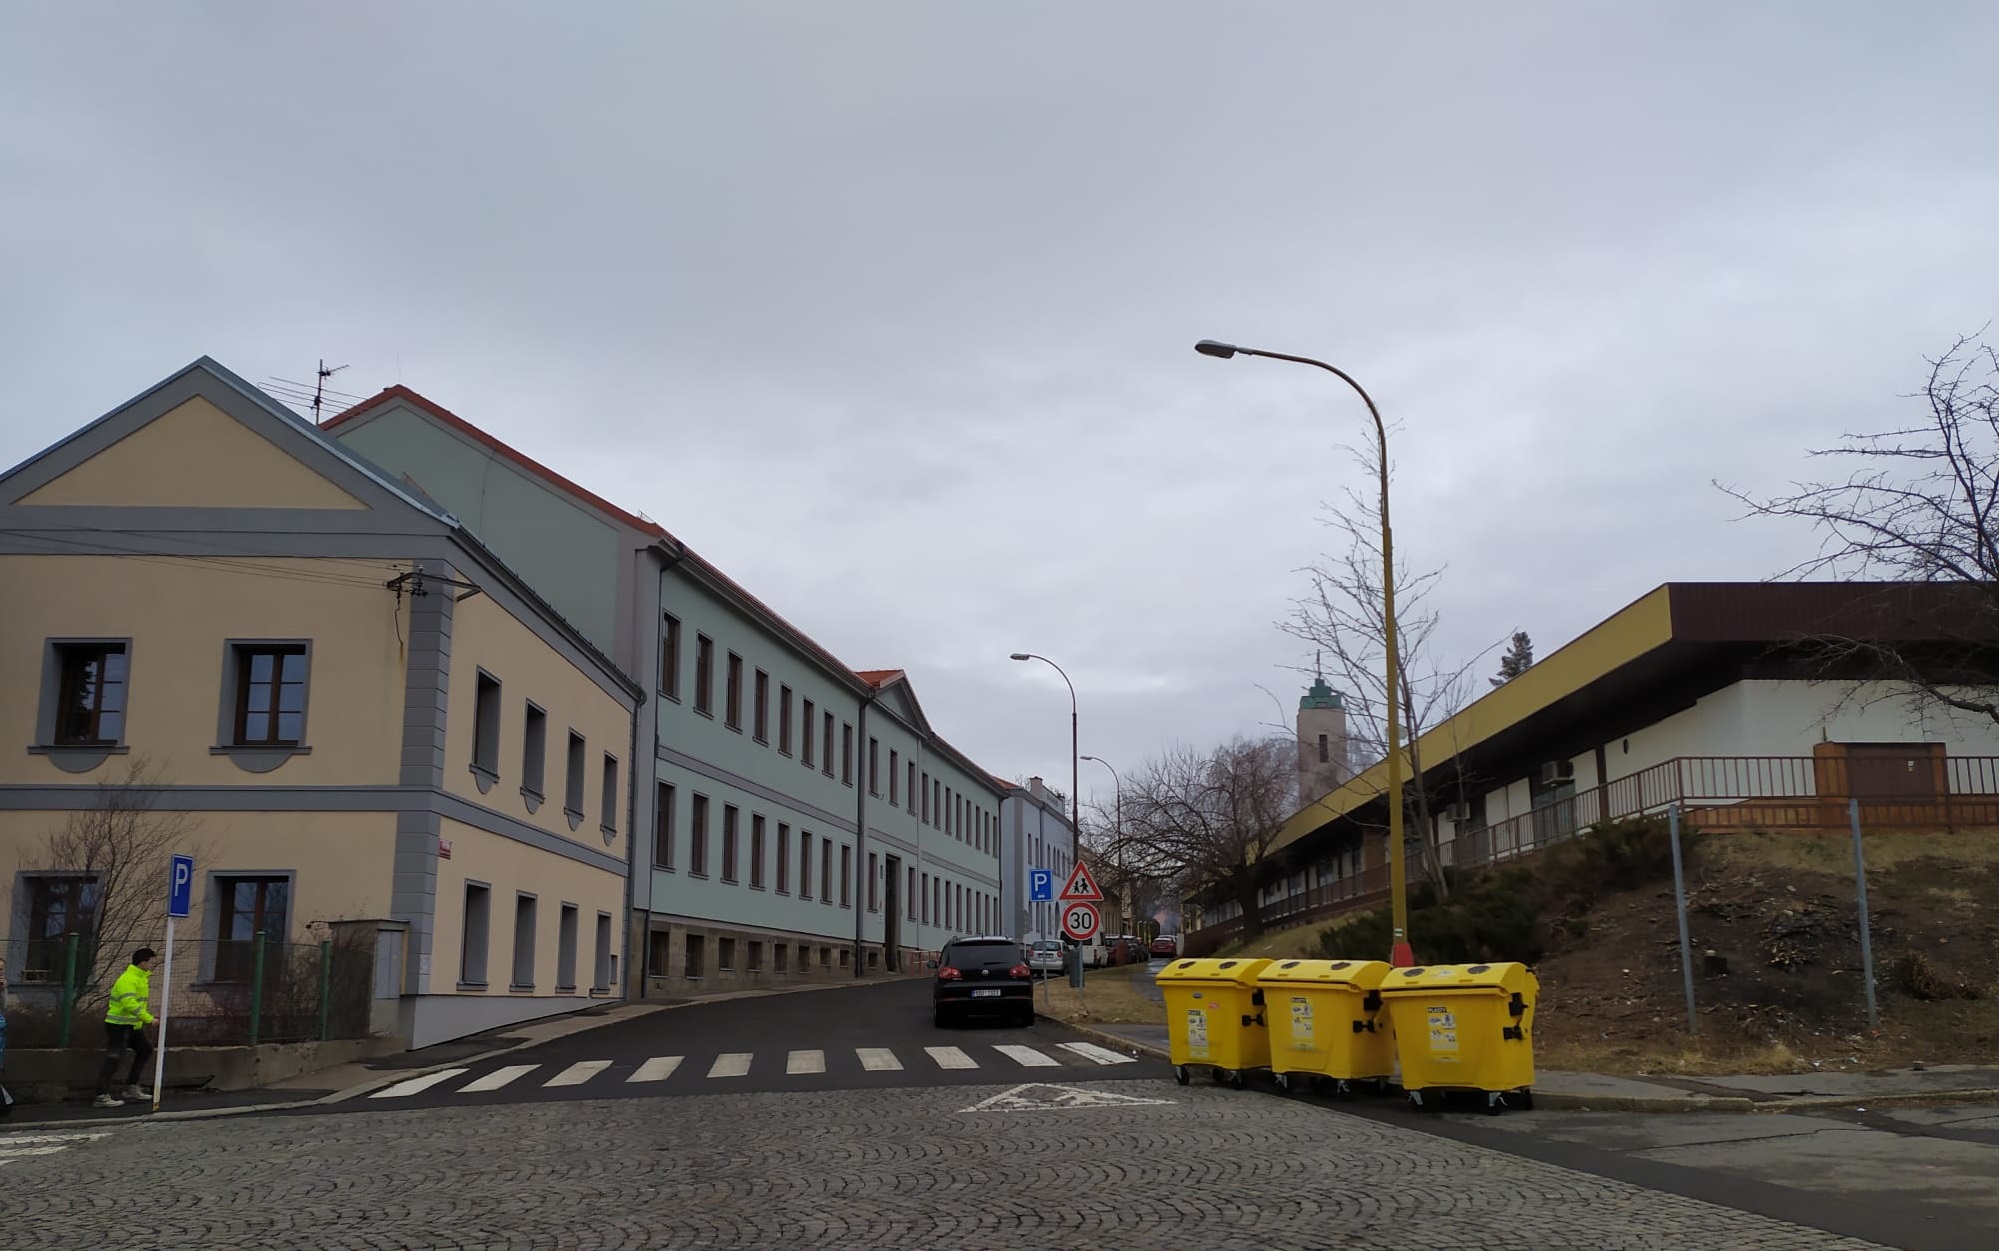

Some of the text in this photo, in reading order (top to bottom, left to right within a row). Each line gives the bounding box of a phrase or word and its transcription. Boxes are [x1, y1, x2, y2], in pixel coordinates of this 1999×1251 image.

[174, 863, 188, 897] P
[1034, 873, 1048, 892] P
[1070, 912, 1092, 930] 30
